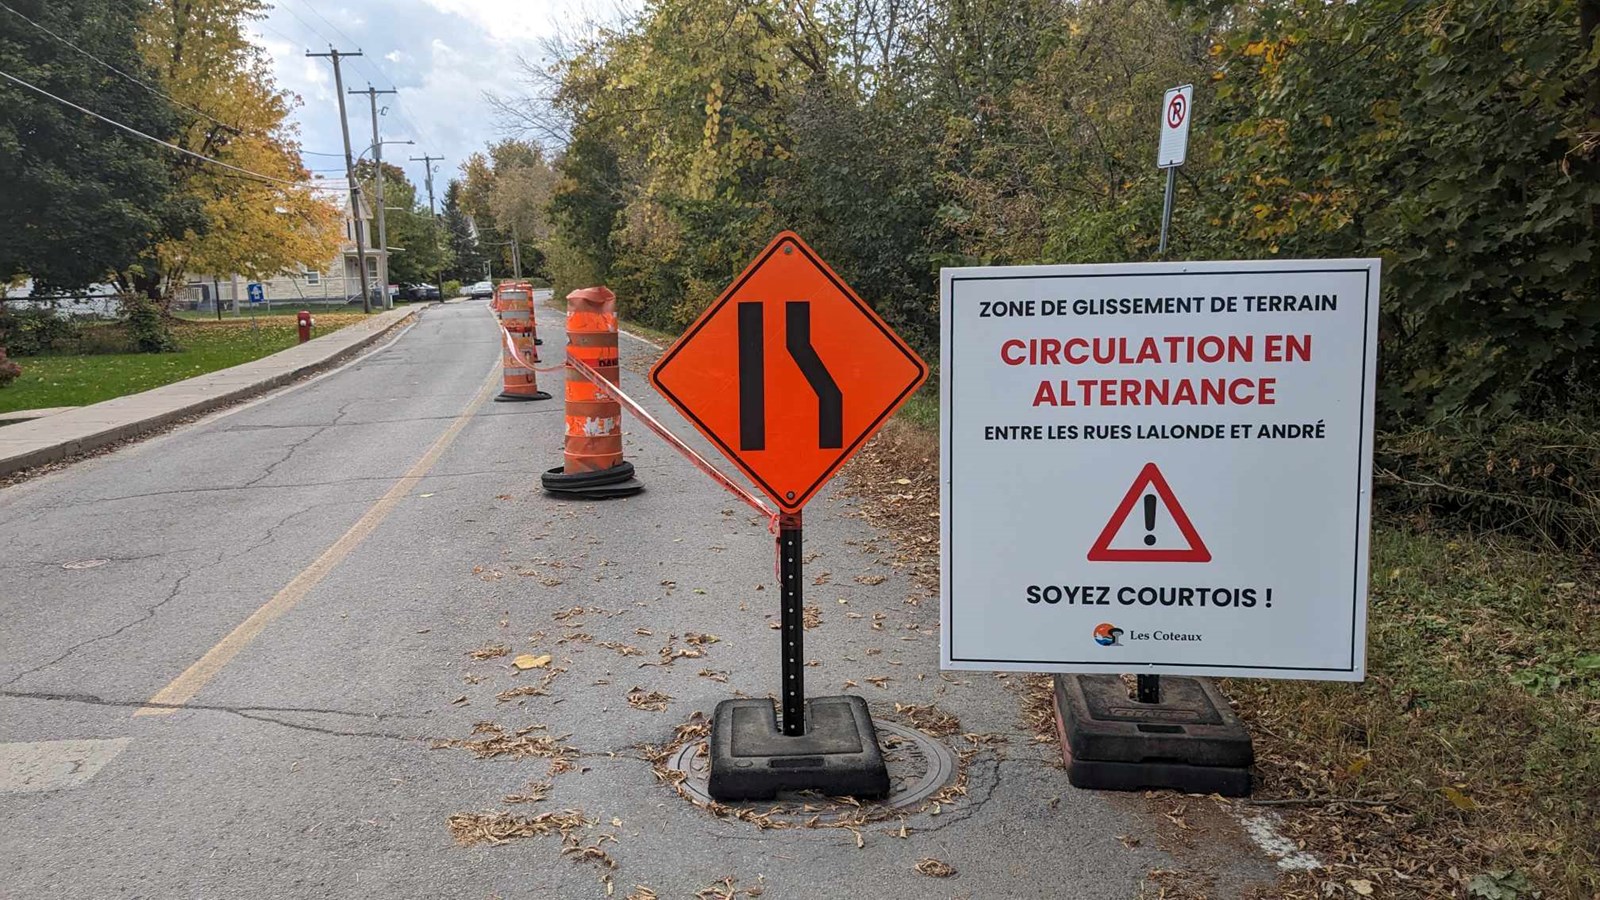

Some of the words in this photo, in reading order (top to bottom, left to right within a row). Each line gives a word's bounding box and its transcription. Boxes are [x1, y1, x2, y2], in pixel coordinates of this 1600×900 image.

[979, 300, 1036, 318] ZONE
[1040, 299, 1068, 317] DE
[1072, 297, 1206, 316] GLISSEMENT
[1210, 296, 1238, 313] DE
[1242, 294, 1338, 313] TERRAIN
[1000, 335, 1254, 367] CIRCULATION
[1264, 334, 1312, 363] EN
[1032, 377, 1277, 407] ALTERNANCE
[984, 425, 1043, 441] ENTRE
[1047, 425, 1079, 440] LES
[1083, 424, 1132, 440] RUES
[1136, 424, 1226, 440] LALONDE
[1230, 424, 1253, 439] ET
[1256, 418, 1326, 439] ANDRÉ
[1026, 585, 1111, 606] SOYEZ
[1116, 586, 1257, 608] COURTOIS
[1129, 630, 1150, 641] Les
[1153, 630, 1203, 642] Coteaux
